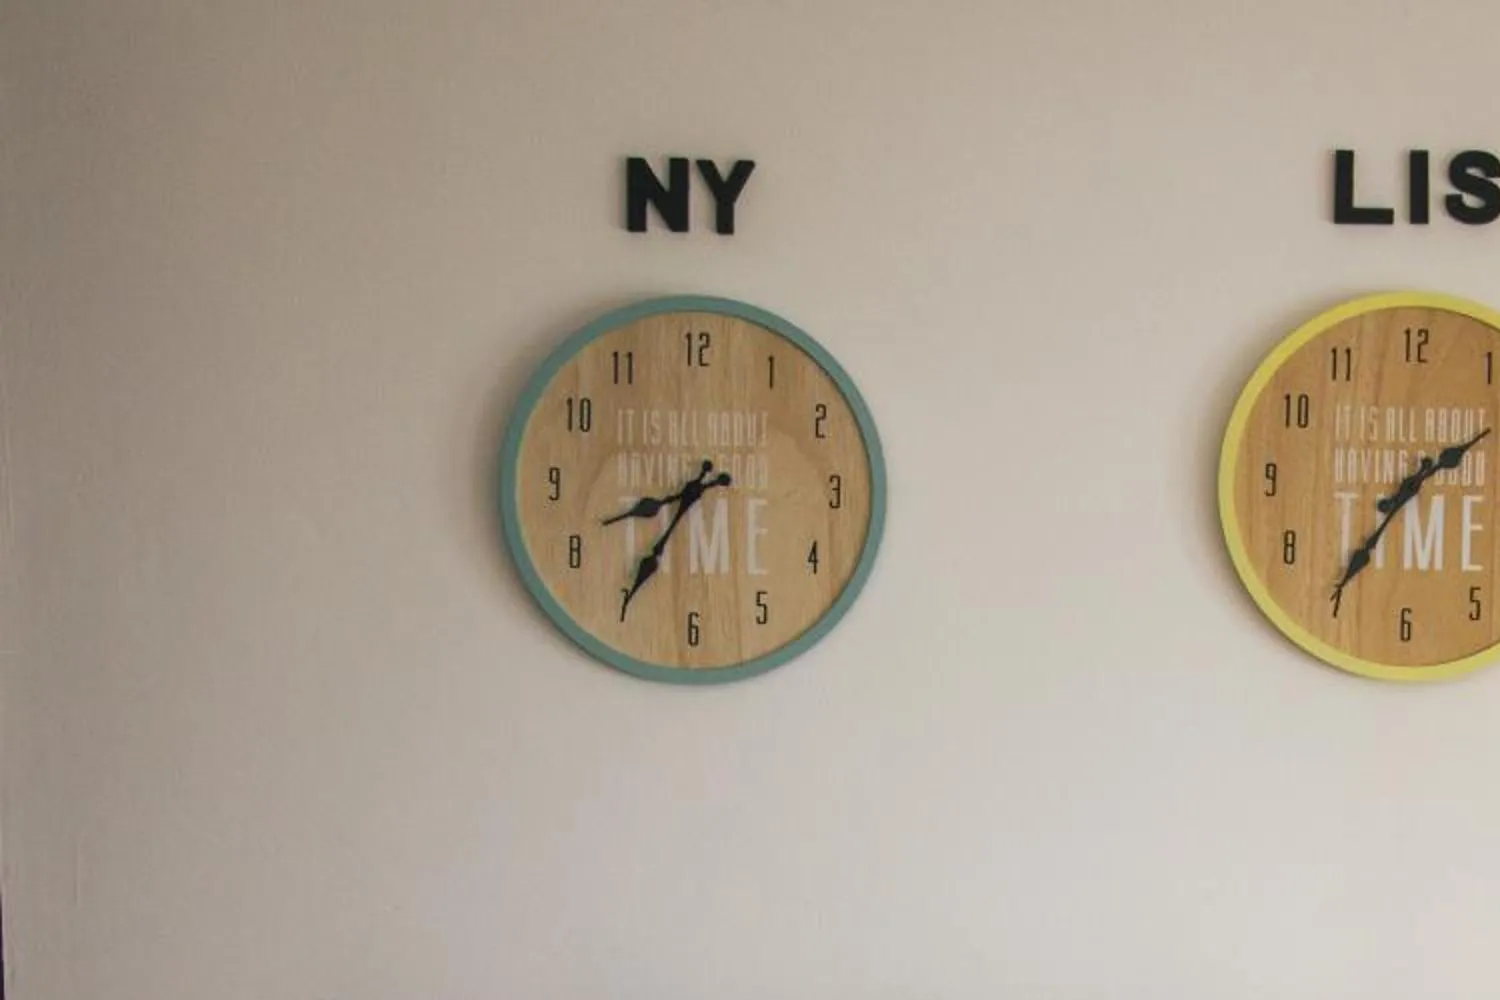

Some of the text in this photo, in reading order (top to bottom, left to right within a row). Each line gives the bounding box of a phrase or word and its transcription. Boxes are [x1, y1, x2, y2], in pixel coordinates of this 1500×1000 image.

[626, 157, 756, 235] NY
[685, 332, 711, 366] 12
[1404, 328, 1430, 363] 12
[612, 352, 633, 384] 11
[767, 356, 775, 388] 1
[1331, 348, 1352, 381] 11
[1486, 352, 1493, 384] 1
[566, 398, 592, 432] 10
[617, 409, 768, 446] IT IS ALL ABOUT
[815, 404, 827, 438] 2
[1284, 394, 1310, 428] 10
[1335, 405, 1486, 443] IT IS ALL ABOUT
[548, 467, 561, 501] 9
[828, 475, 841, 509] 3
[1265, 463, 1278, 496] 9
[617, 496, 769, 575] TIME
[1283, 530, 1297, 564] 8
[1334, 491, 1484, 572] TIME
[569, 535, 582, 568] 8
[807, 541, 819, 574] 4
[755, 592, 768, 624] 5
[1468, 587, 1481, 620] 5
[687, 612, 700, 646] 6
[1400, 608, 1412, 641] 6
